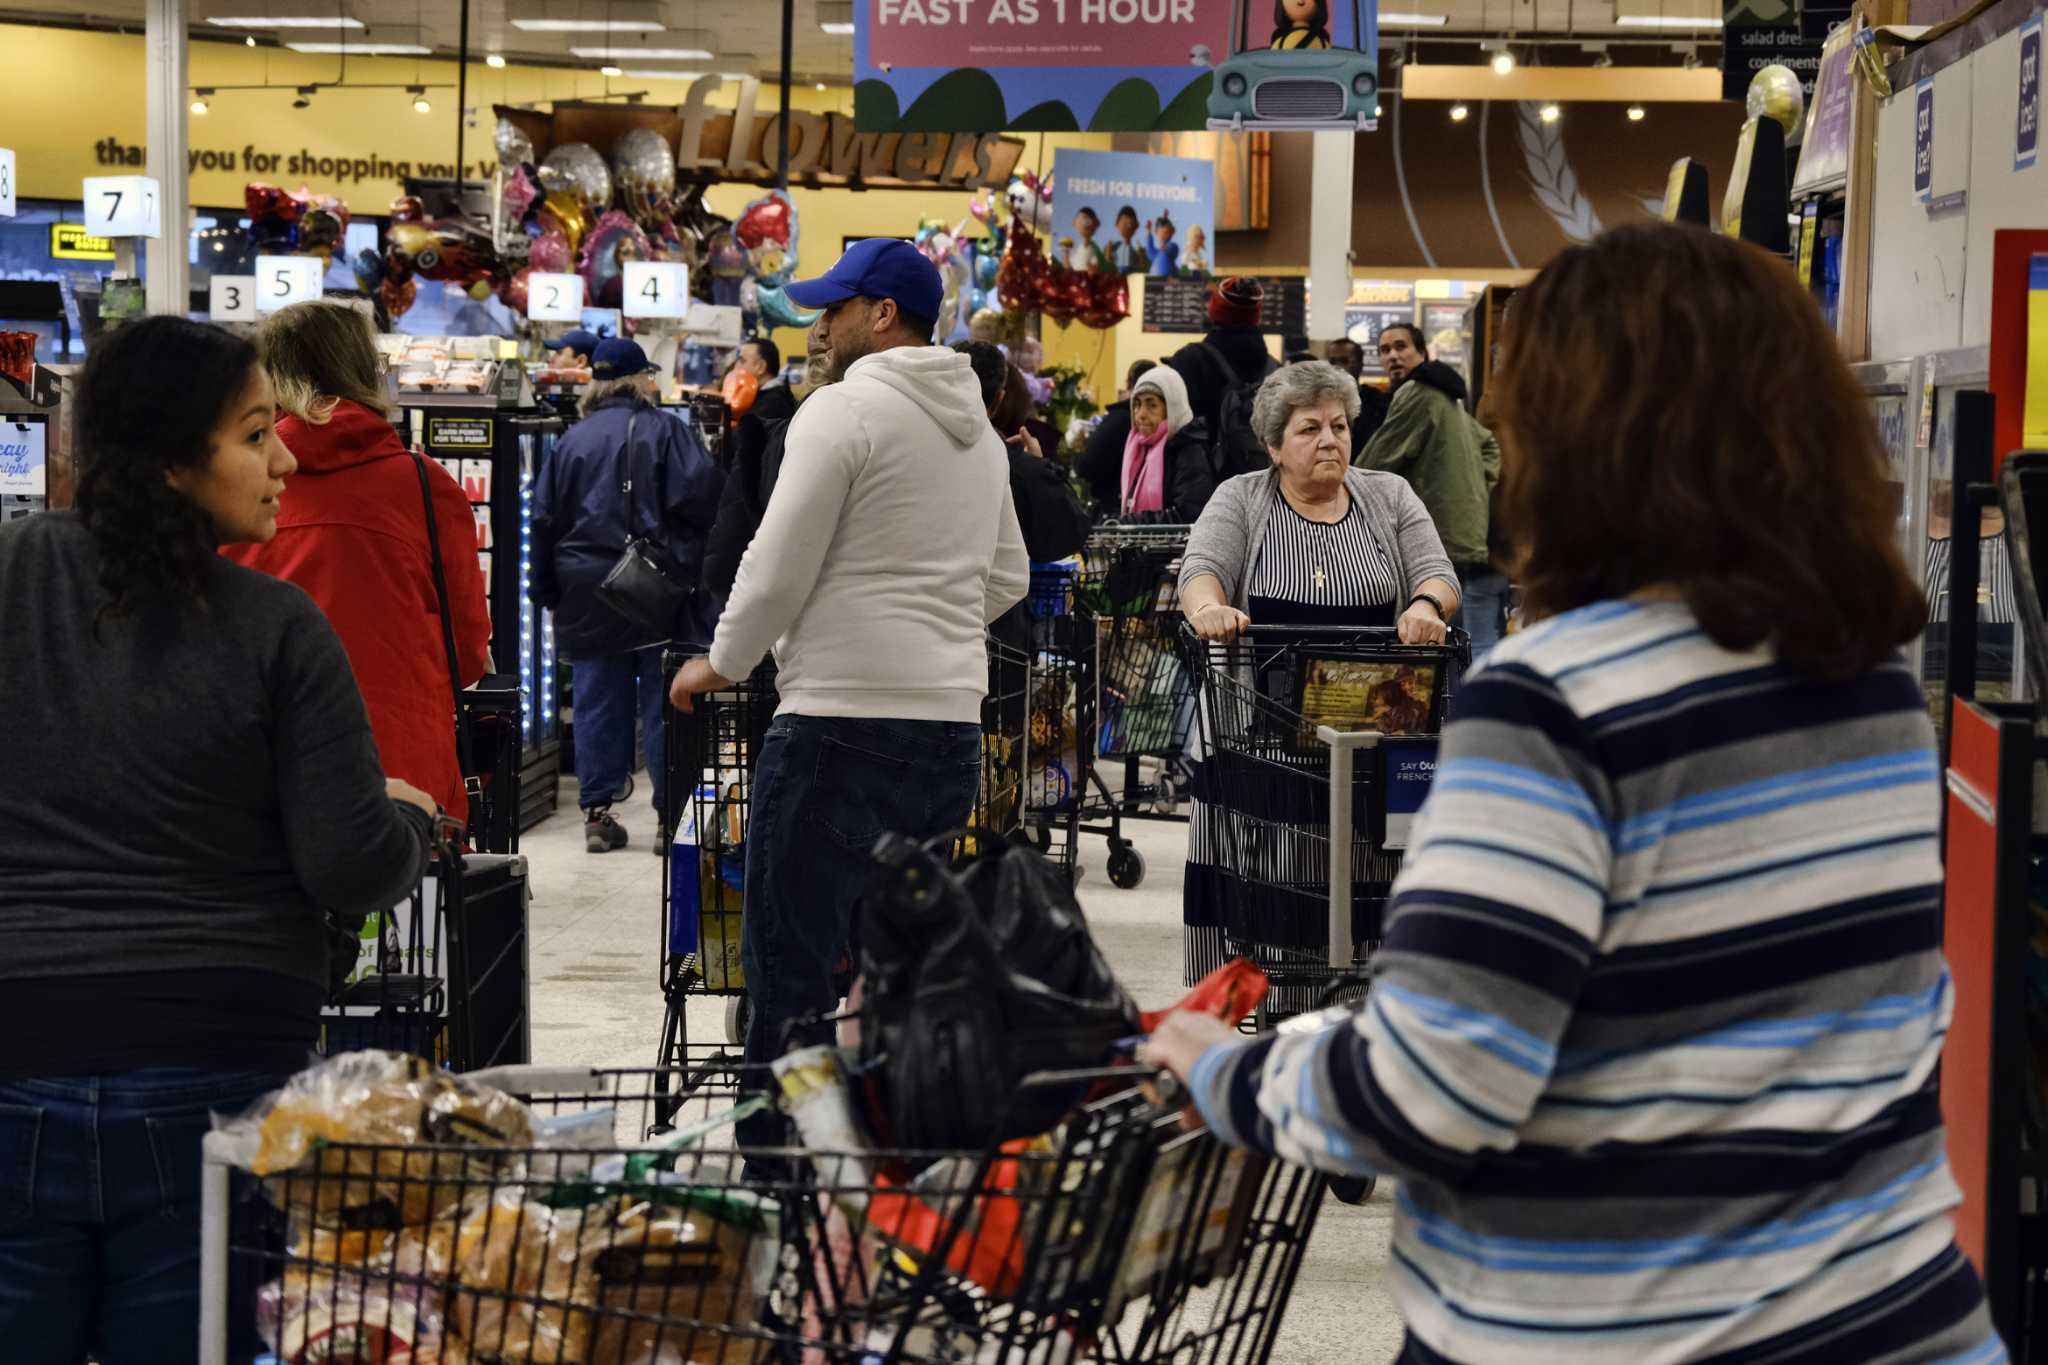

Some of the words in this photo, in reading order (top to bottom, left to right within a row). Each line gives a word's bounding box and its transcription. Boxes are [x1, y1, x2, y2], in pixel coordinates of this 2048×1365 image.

[879, 0, 970, 25] FAST
[987, 0, 1040, 25] AS
[1056, 0, 1066, 25] 1
[1080, 0, 1197, 25] HOUR
[1741, 29, 1774, 45] salad
[678, 73, 1001, 189] flowers
[188, 149, 235, 174] you
[243, 145, 281, 173] for
[288, 148, 411, 187] shopping
[1, 164, 8, 199] 8
[1067, 177, 1105, 195] FRESH
[1108, 180, 1134, 198] FOR
[103, 191, 123, 223] 7
[273, 270, 291, 297] 5
[641, 276, 661, 303] 4
[225, 286, 240, 310] 3
[544, 285, 560, 309] 2
[1400, 762, 1417, 771] SAY
